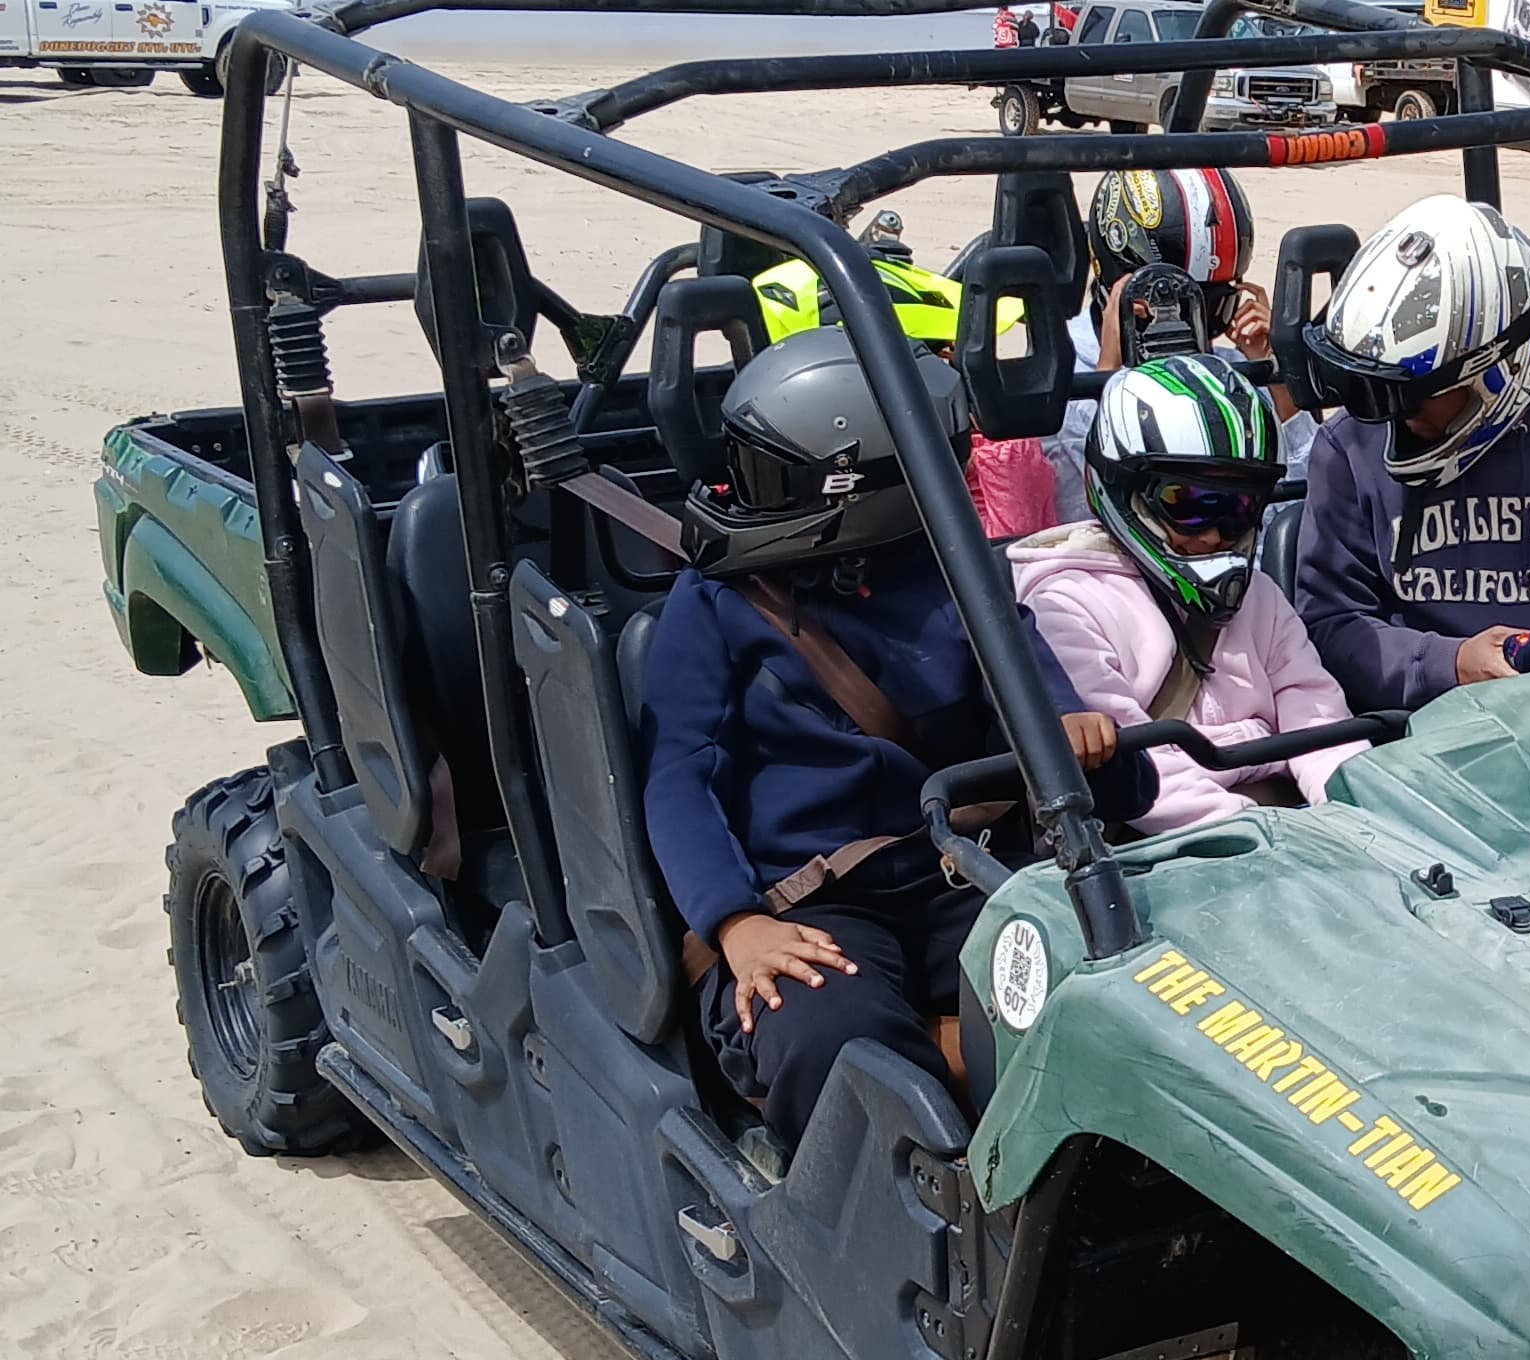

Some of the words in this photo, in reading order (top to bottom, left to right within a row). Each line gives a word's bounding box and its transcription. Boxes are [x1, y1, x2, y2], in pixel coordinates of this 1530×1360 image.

[1014, 923, 1035, 952] UV
[1133, 950, 1225, 1017] THE
[1004, 985, 1027, 1016] 607
